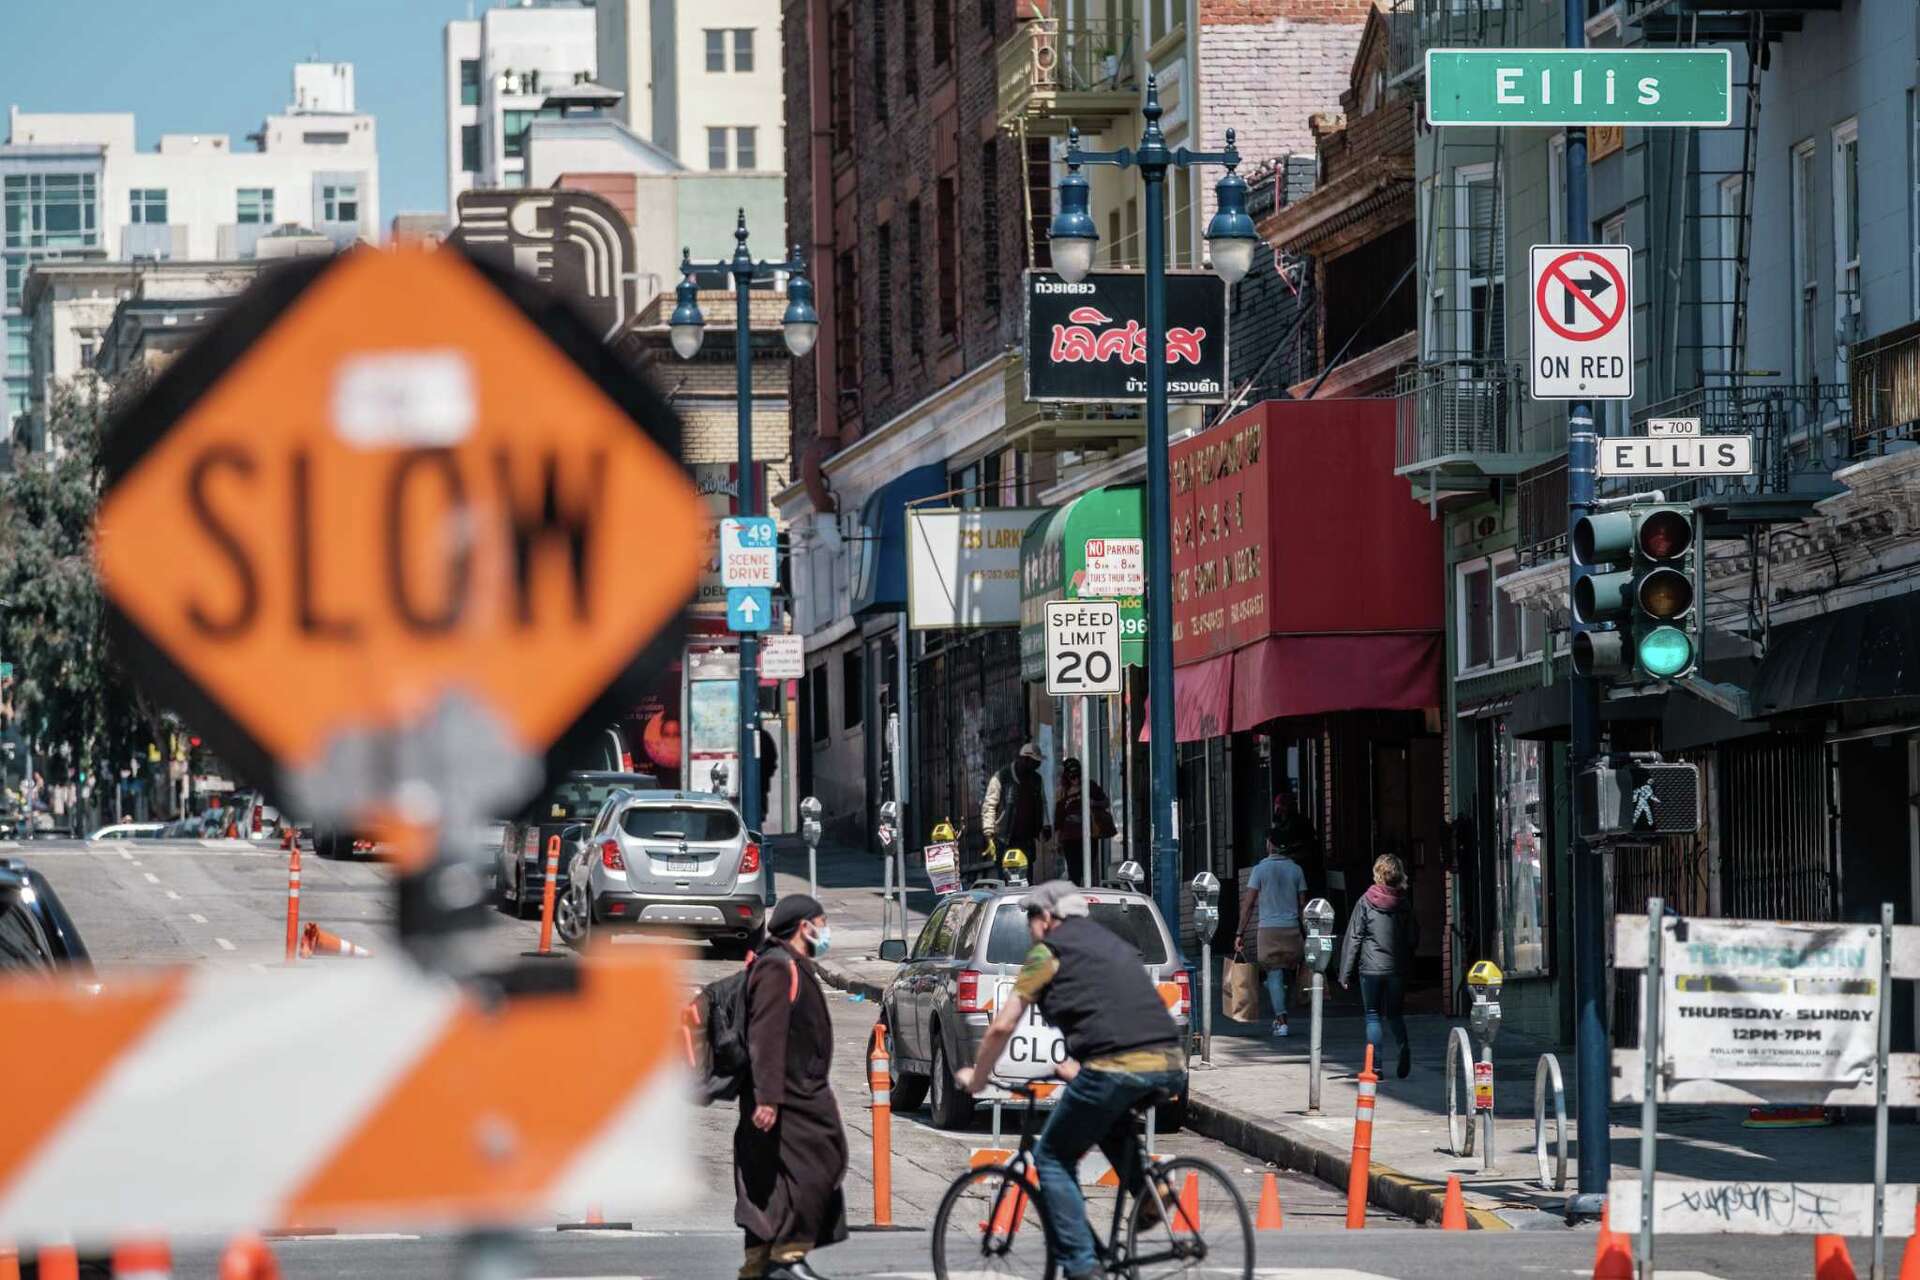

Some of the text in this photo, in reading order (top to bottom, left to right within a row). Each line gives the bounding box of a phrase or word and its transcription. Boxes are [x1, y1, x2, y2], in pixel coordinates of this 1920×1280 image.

[1497, 68, 1660, 104] Ellis
[1540, 356, 1624, 379] ON RED
[1668, 421, 1693, 434] 700
[1616, 443, 1736, 468] ELLIS
[747, 523, 772, 541] 49
[186, 440, 609, 643] SLOW
[1089, 541, 1140, 556] NO PARKING
[728, 554, 769, 566] SCENIC
[729, 567, 769, 580] DRIVE
[1052, 612, 1113, 627] SPEED
[1060, 632, 1107, 645] LIMIT
[1056, 651, 1112, 684] 20
[1797, 1009, 1874, 1022] SUNDAY
[1732, 1028, 1822, 1041] 12PM-7PM
[1009, 1036, 1067, 1064] CLO
